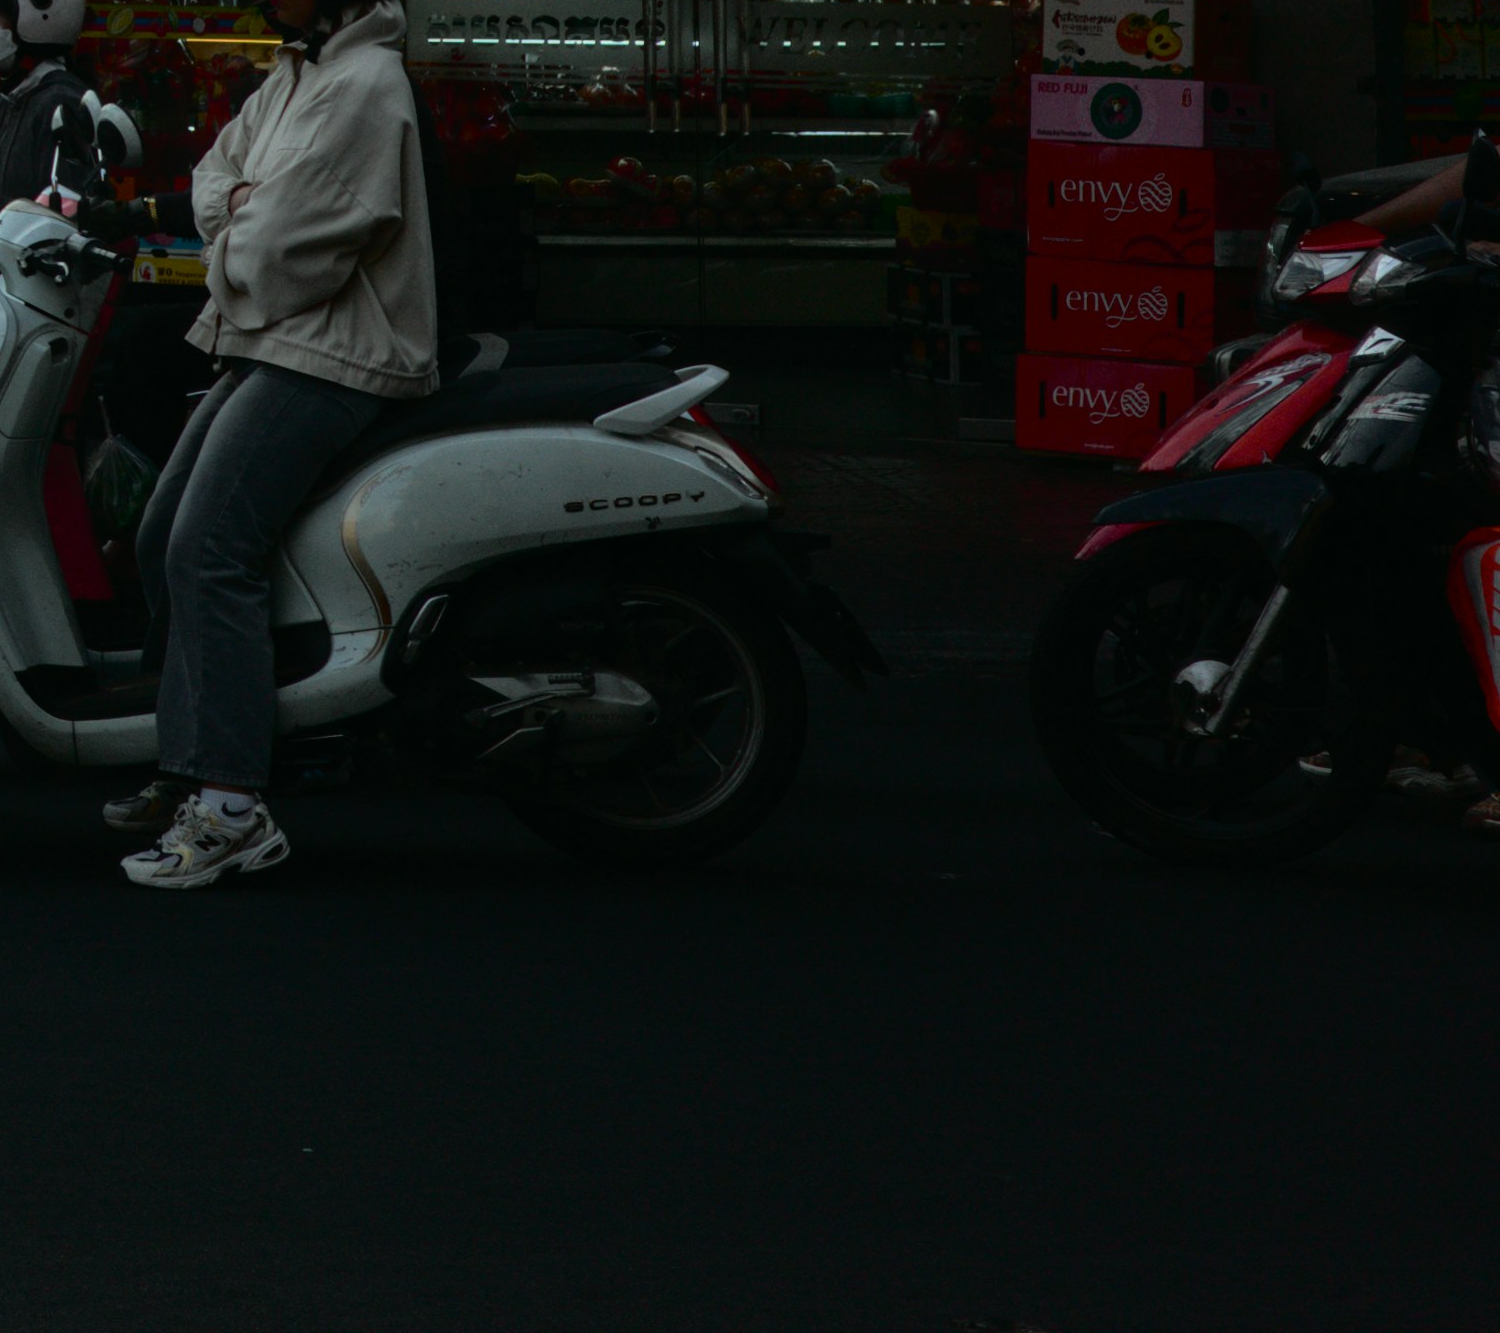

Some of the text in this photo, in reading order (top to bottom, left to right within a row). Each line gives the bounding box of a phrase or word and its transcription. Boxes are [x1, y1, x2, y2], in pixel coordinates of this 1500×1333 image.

[1037, 81, 1088, 94] RED FUJI
[1059, 176, 1140, 222] envy
[1065, 288, 1139, 329] envy
[1051, 384, 1122, 425] envy
[563, 490, 705, 513] SCOOPY
